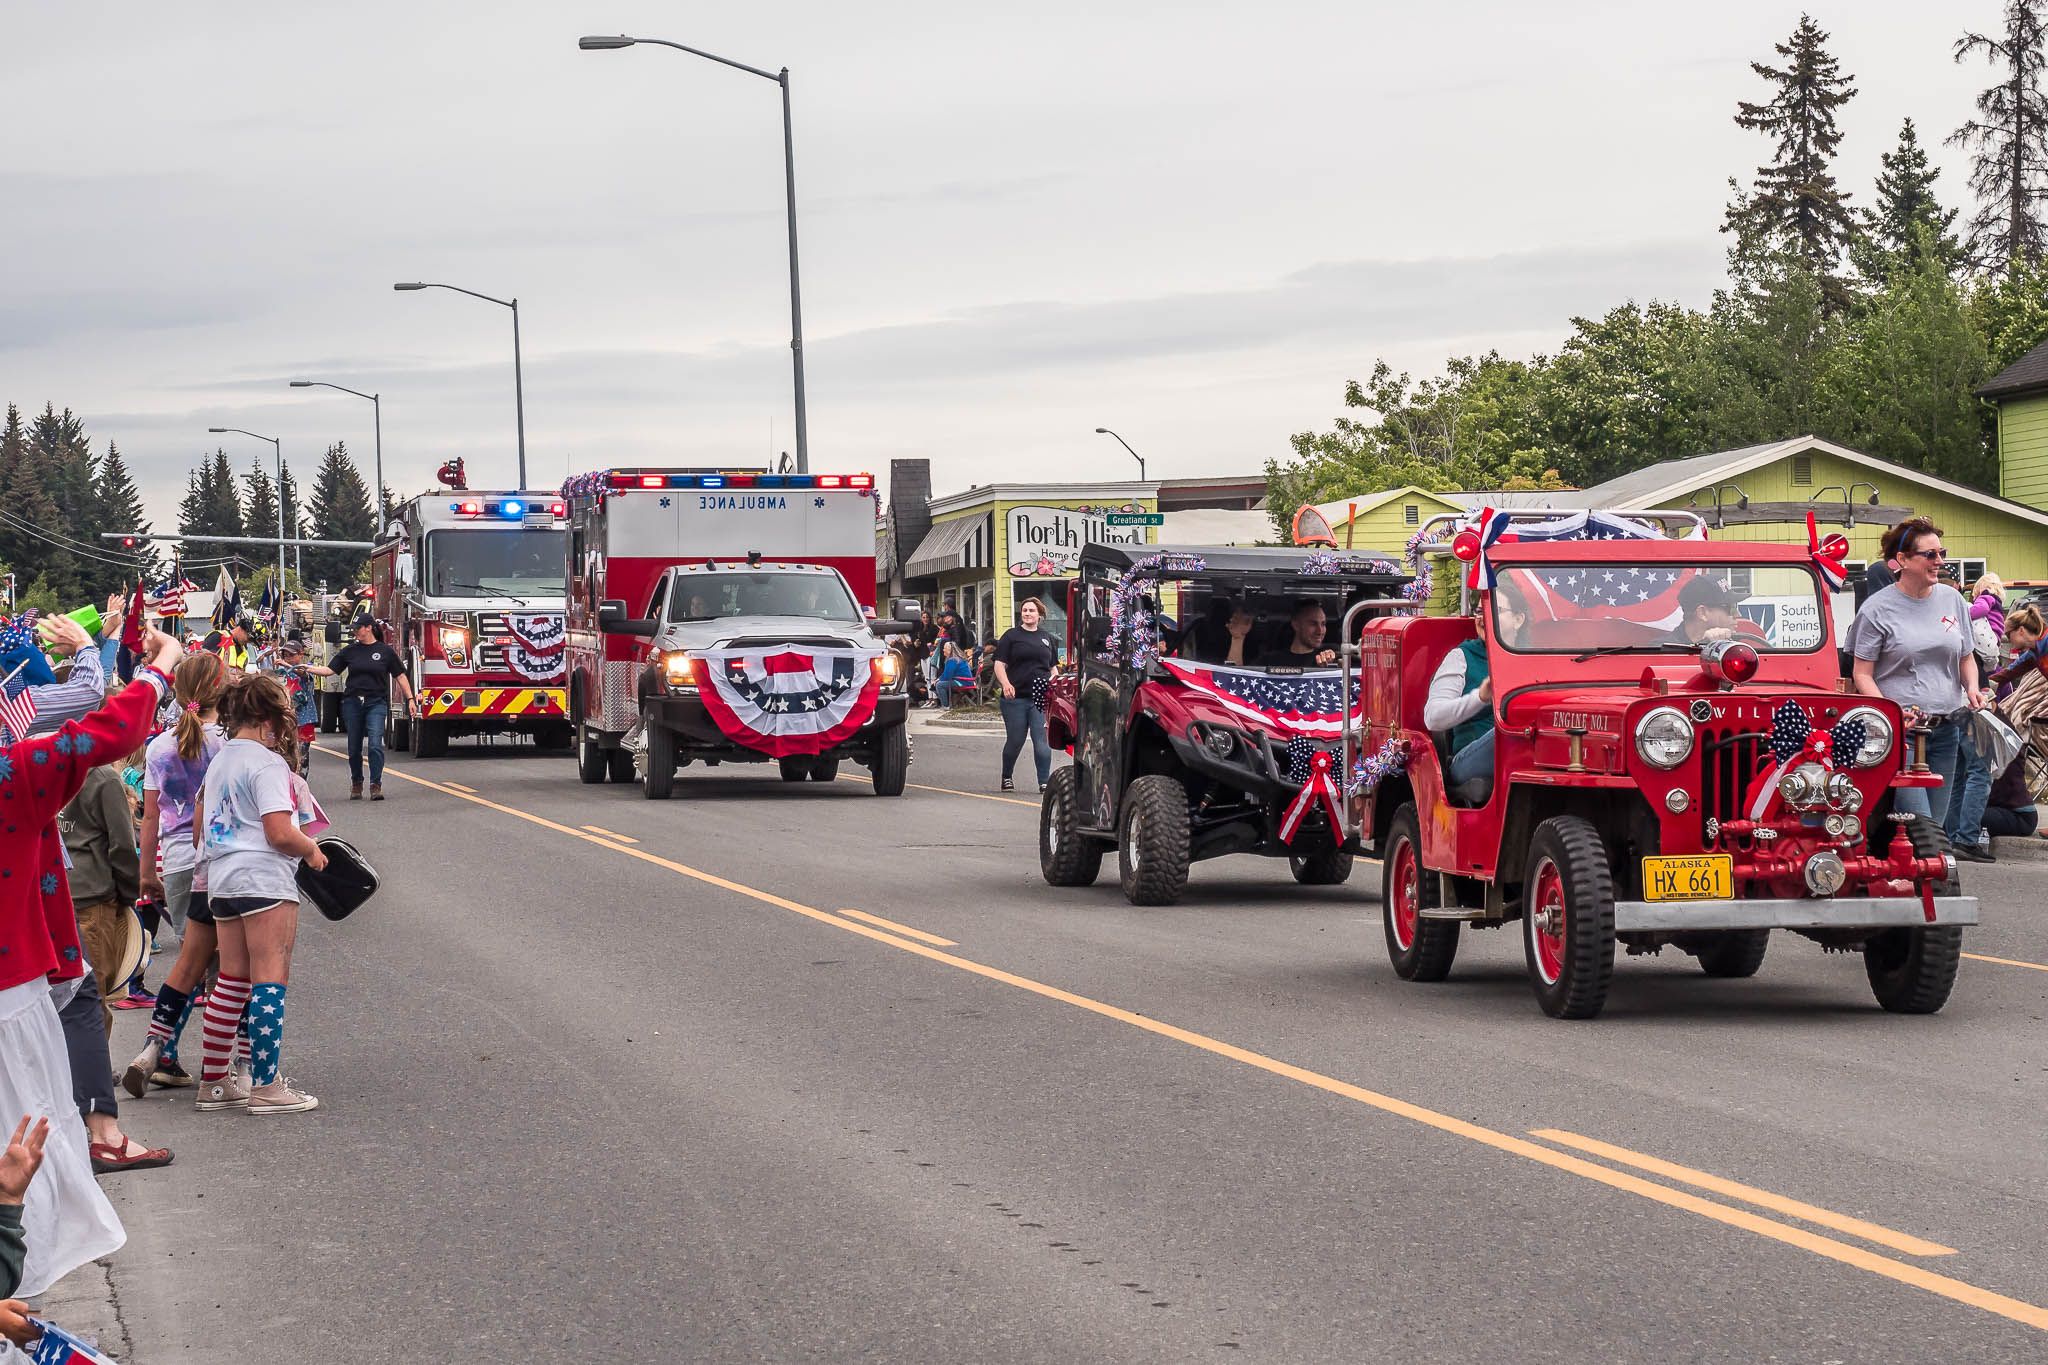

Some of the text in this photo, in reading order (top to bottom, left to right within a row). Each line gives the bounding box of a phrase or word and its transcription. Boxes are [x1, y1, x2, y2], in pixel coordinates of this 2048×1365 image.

[1112, 516, 1147, 524] Greatland
[1016, 514, 1078, 549] North
[1041, 548, 1070, 560] Home
[1781, 603, 1816, 616] South
[1781, 619, 1819, 632] Penins
[424, 696, 435, 706] E-3
[1553, 711, 1588, 729] ENGINE
[1664, 860, 1711, 868] ALASKA
[1655, 870, 1719, 892] HX 661
